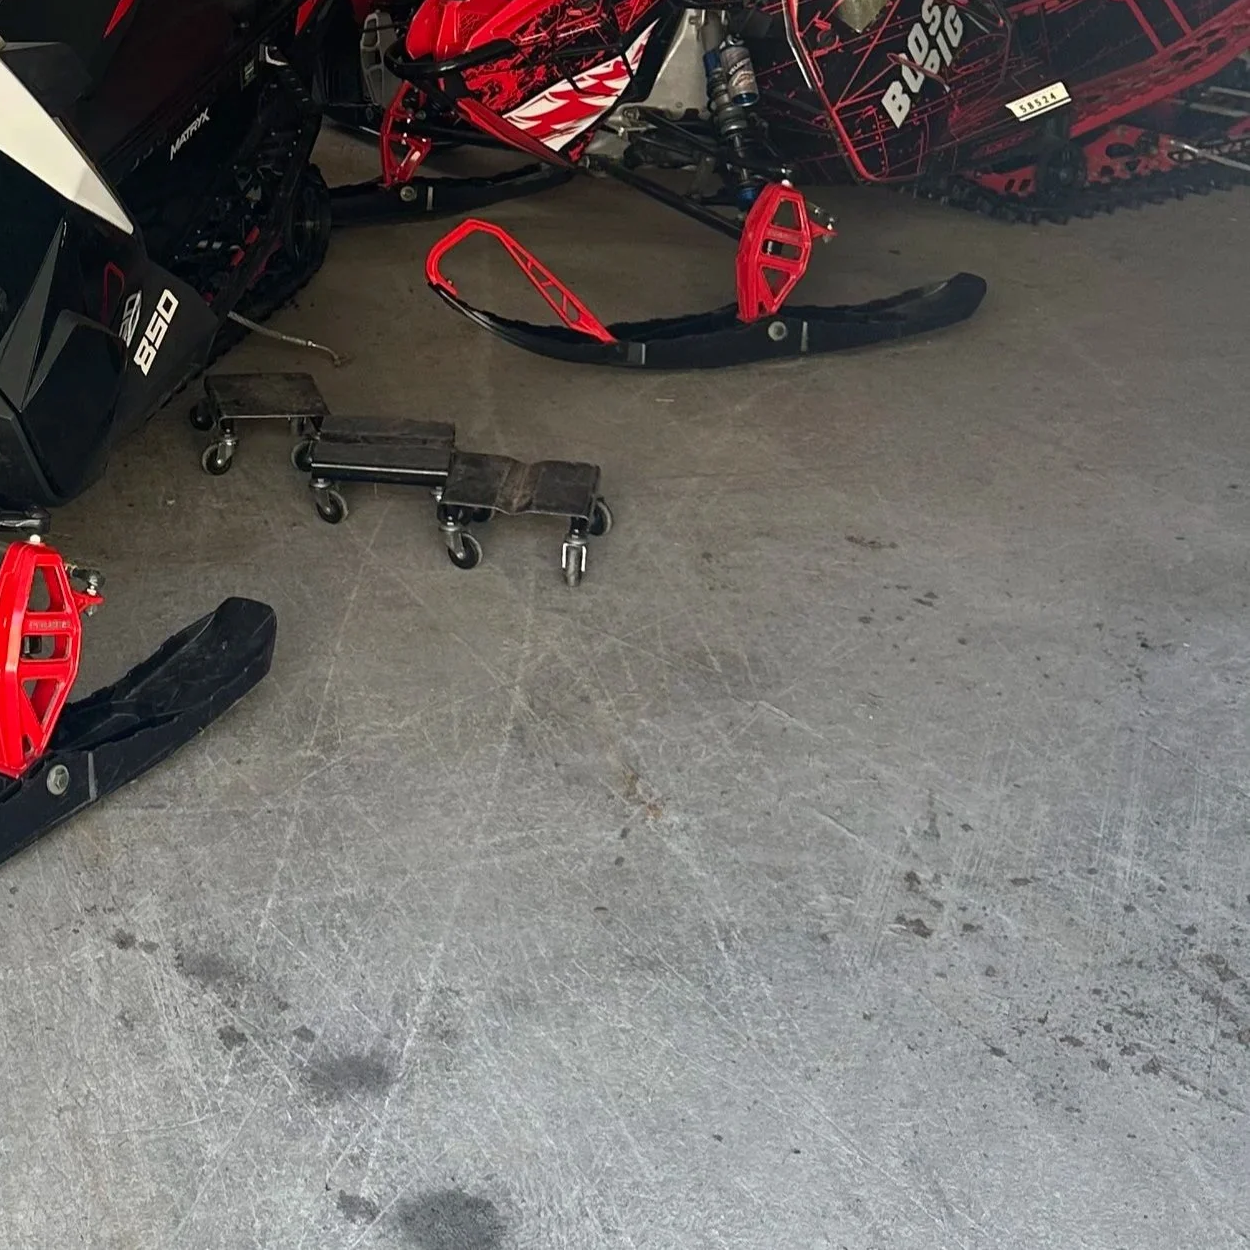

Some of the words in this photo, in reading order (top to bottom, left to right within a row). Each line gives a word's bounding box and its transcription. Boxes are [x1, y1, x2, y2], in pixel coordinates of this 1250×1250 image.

[1018, 92, 1057, 114] 58524
[170, 106, 210, 161] MATRYX
[133, 288, 180, 377] 850
